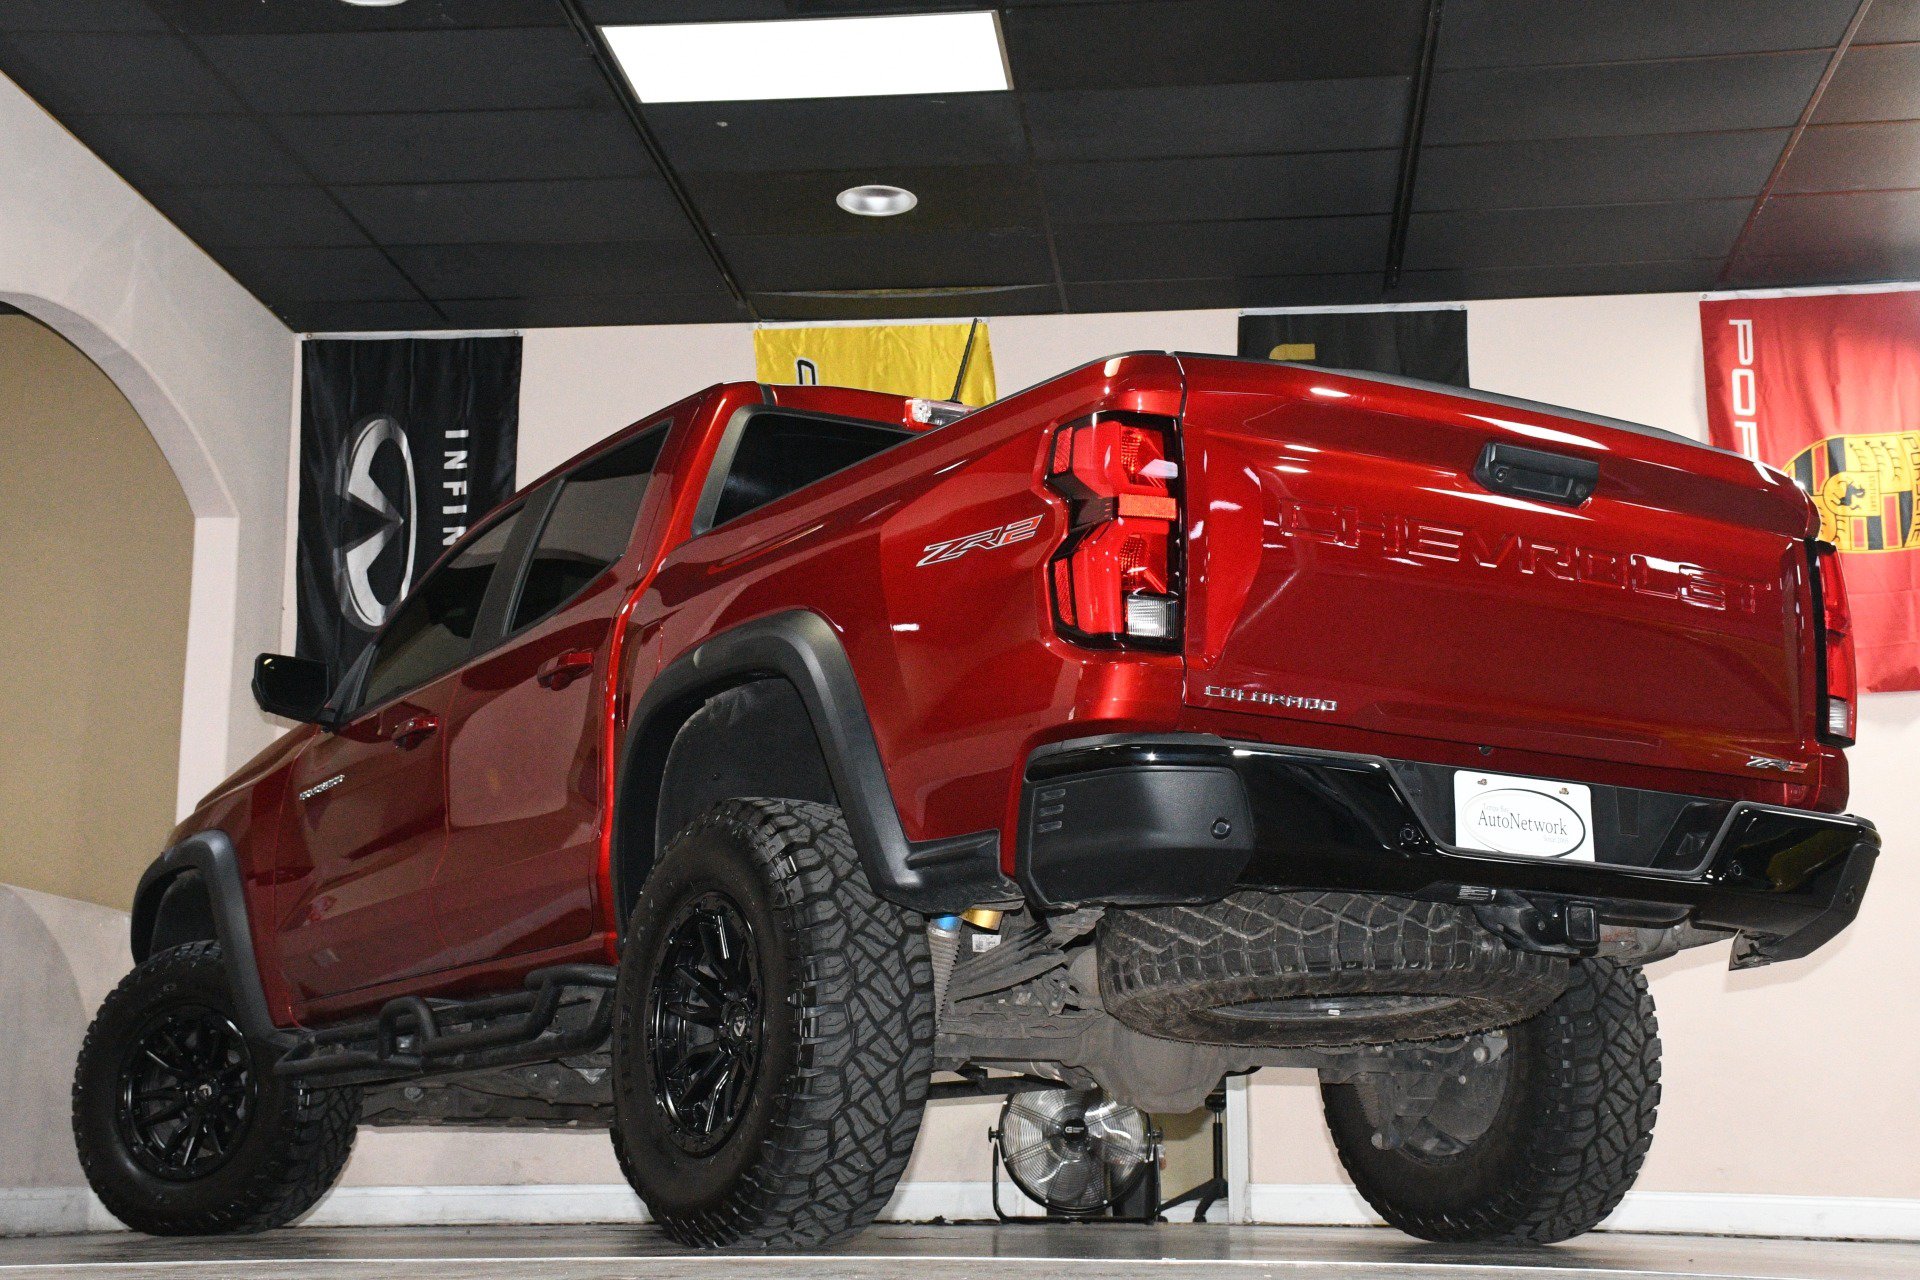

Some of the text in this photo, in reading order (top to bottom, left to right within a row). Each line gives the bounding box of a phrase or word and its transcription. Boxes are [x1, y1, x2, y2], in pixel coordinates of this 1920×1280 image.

[916, 512, 1045, 567] ZR2
[1279, 500, 1772, 614] CHEVROLET
[1204, 685, 1337, 711] COLORADO
[1478, 809, 1568, 836] AutoNetwork
